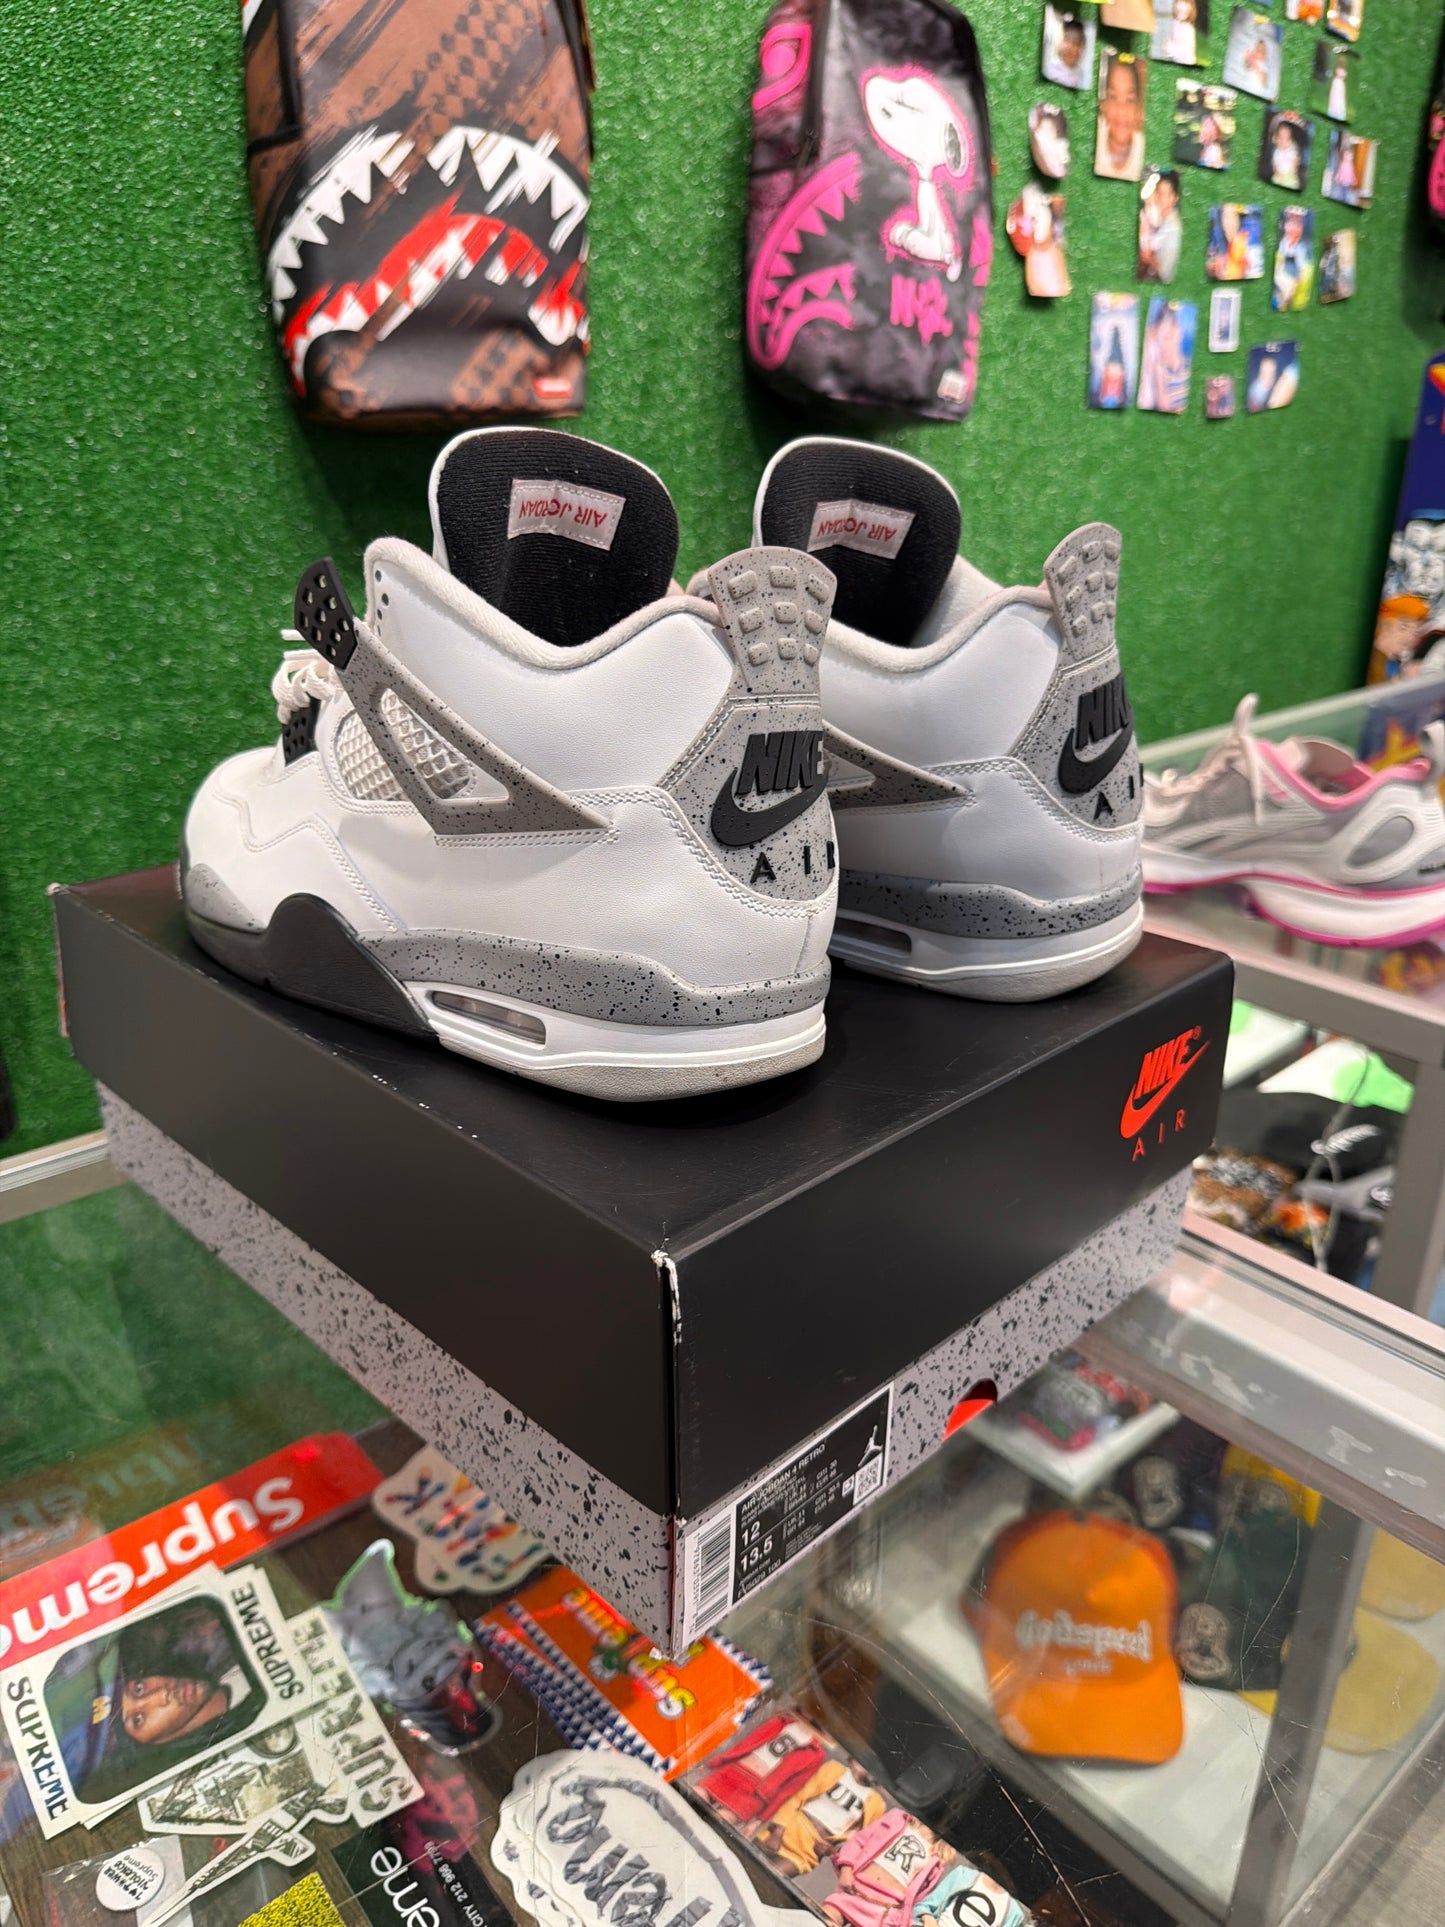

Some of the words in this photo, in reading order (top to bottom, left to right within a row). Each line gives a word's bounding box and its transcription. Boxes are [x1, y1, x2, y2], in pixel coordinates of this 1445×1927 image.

[519, 497, 567, 521] JORDAN
[575, 505, 608, 527] AIR
[817, 517, 867, 537] JORDAN
[869, 521, 897, 542] AIR
[734, 731, 824, 797] NIKE
[1131, 1108, 1186, 1161] AIR
[741, 1496, 756, 1514] AIR
[757, 1470, 790, 1501] JORDAN
[791, 1465, 797, 1474] 4
[798, 1443, 825, 1469] RETRO
[742, 1521, 760, 1547] 12
[741, 1535, 773, 1572] 13.5
[231, 1580, 303, 1701] SUPREME
[6, 1673, 70, 1821] SUPREME
[123, 1855, 158, 1882] Supreme
[438, 1863, 456, 1883] 966
[450, 1881, 468, 1902] 212
[463, 1903, 484, 1927] CITY
